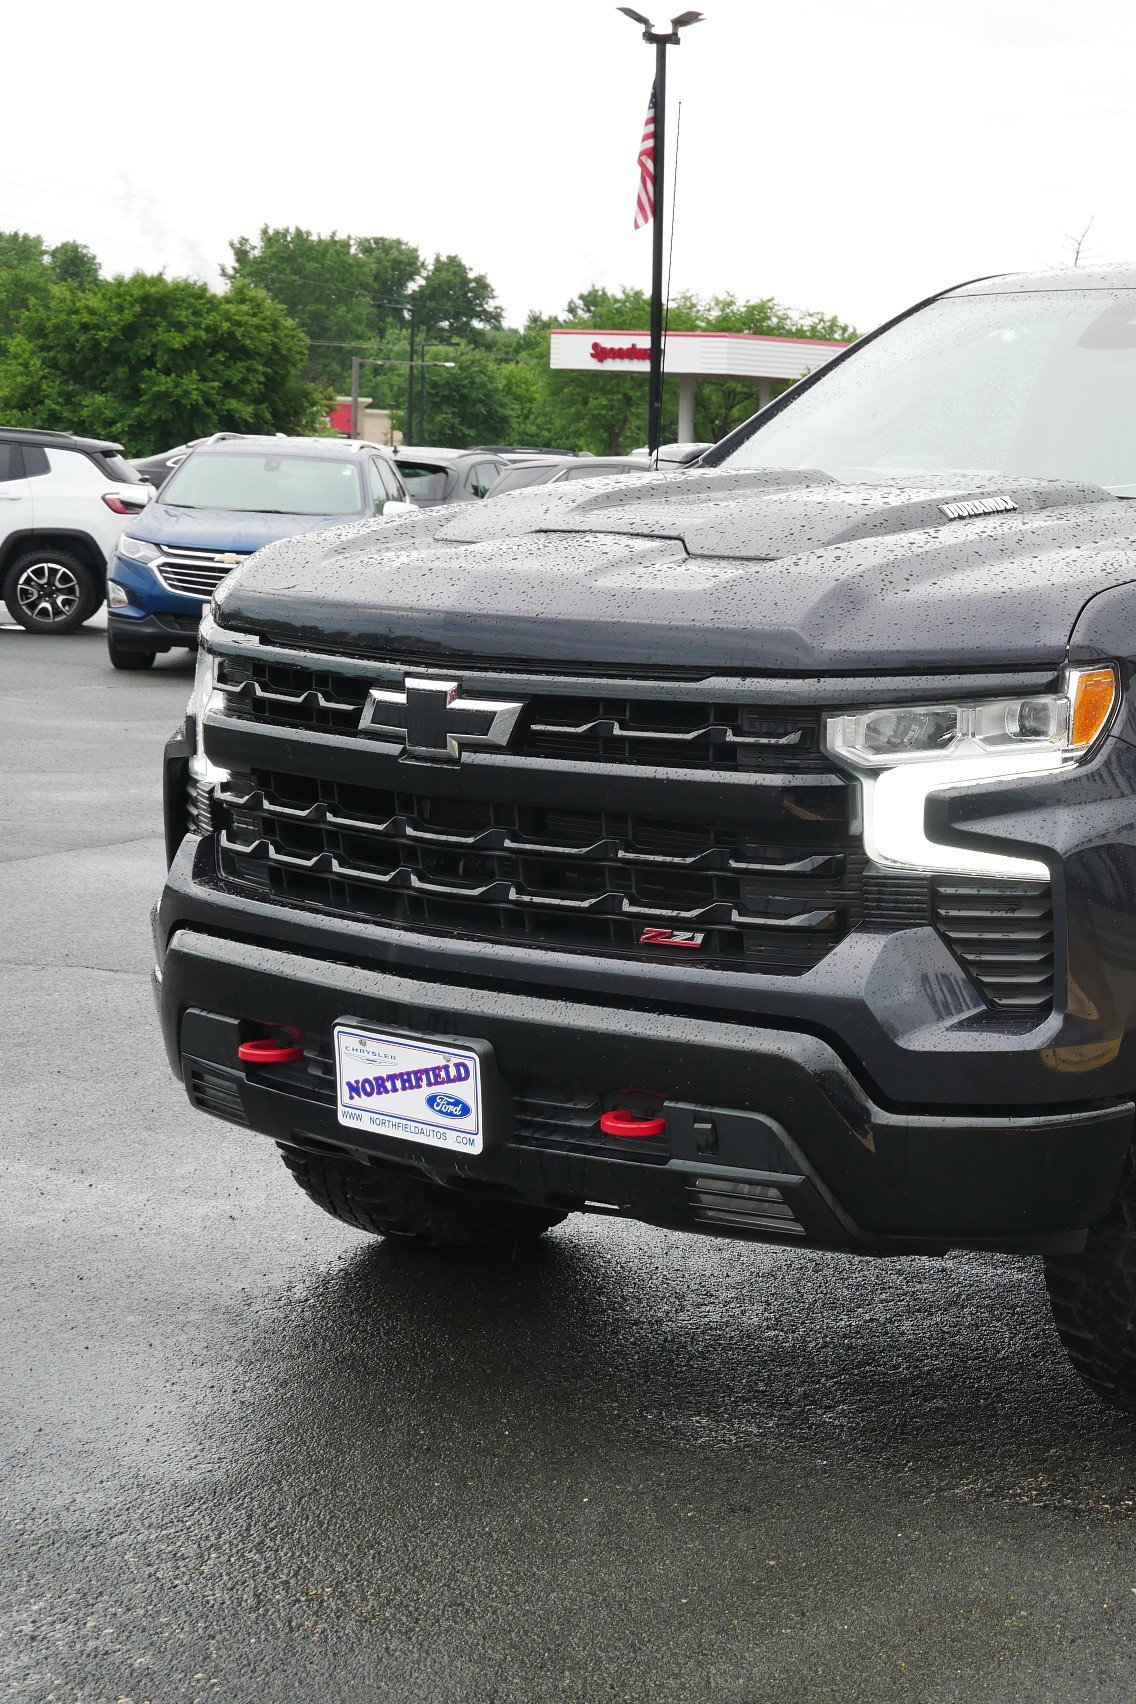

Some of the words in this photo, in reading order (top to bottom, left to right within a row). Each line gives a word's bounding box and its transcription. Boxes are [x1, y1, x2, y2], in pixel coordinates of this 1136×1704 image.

[641, 928, 704, 947] Z71
[344, 1045, 397, 1061] CHRYSLER
[346, 1062, 470, 1100] NORTHFIELD
[433, 1095, 462, 1115] Ford
[369, 1116, 448, 1140] NORTHFIELDAUTOS
